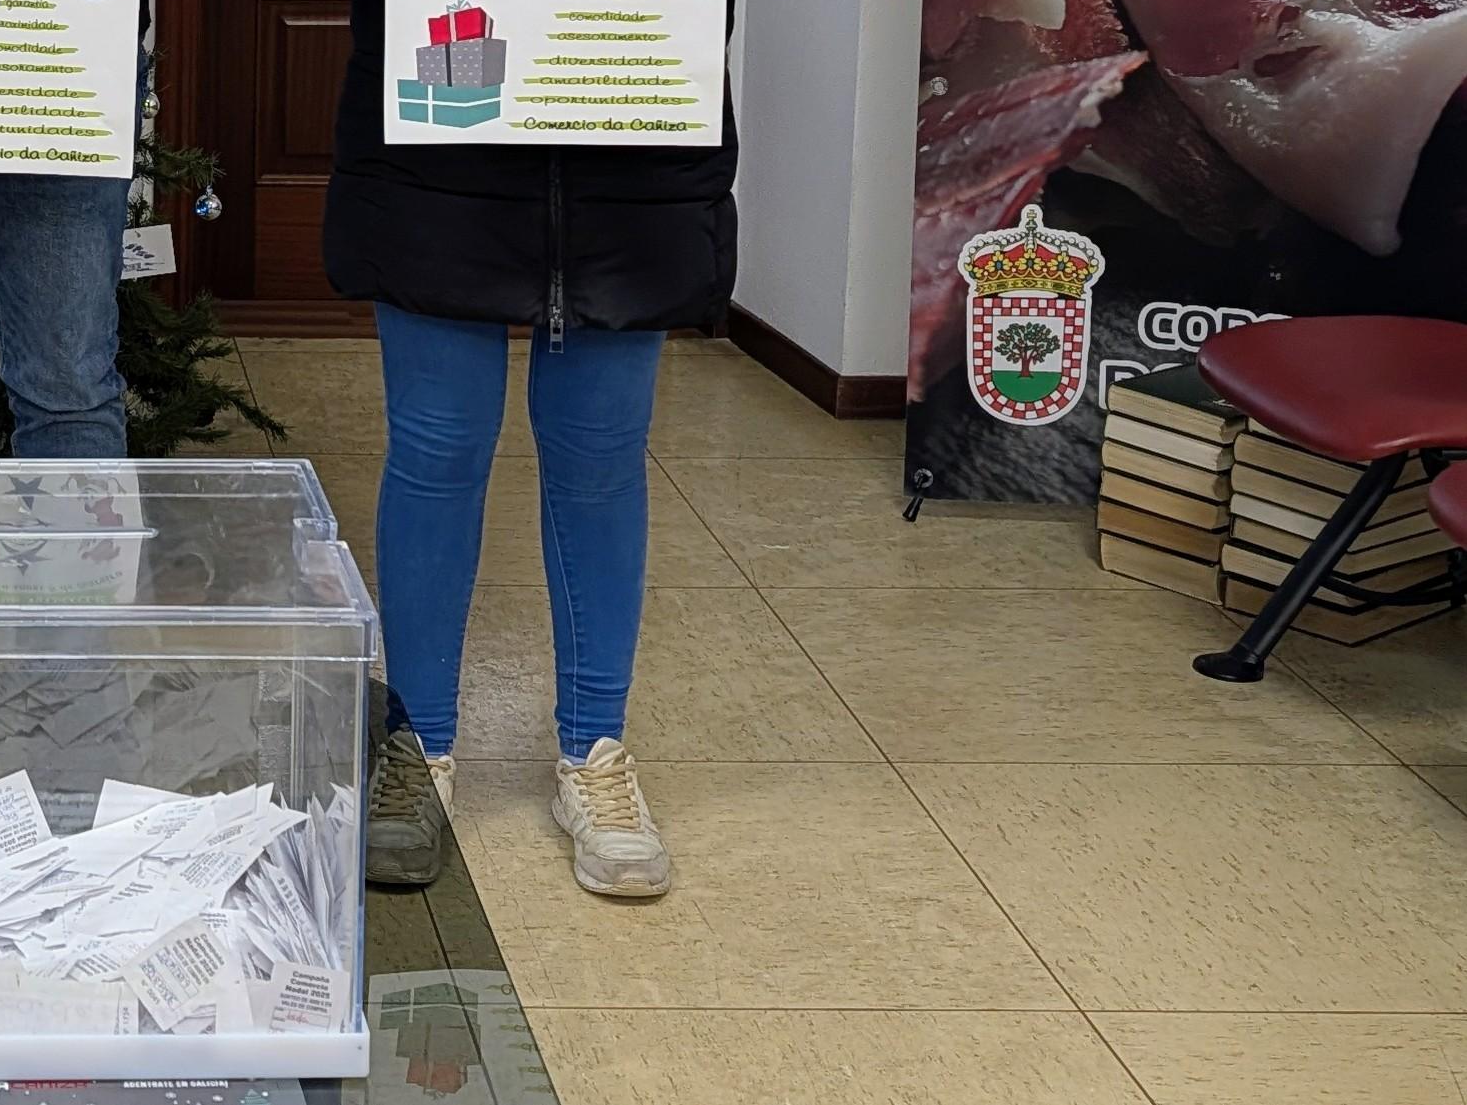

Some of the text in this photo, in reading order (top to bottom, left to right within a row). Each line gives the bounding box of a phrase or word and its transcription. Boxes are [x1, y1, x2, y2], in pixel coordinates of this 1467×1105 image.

[523, 116, 688, 132] Comercio da Cañiza
